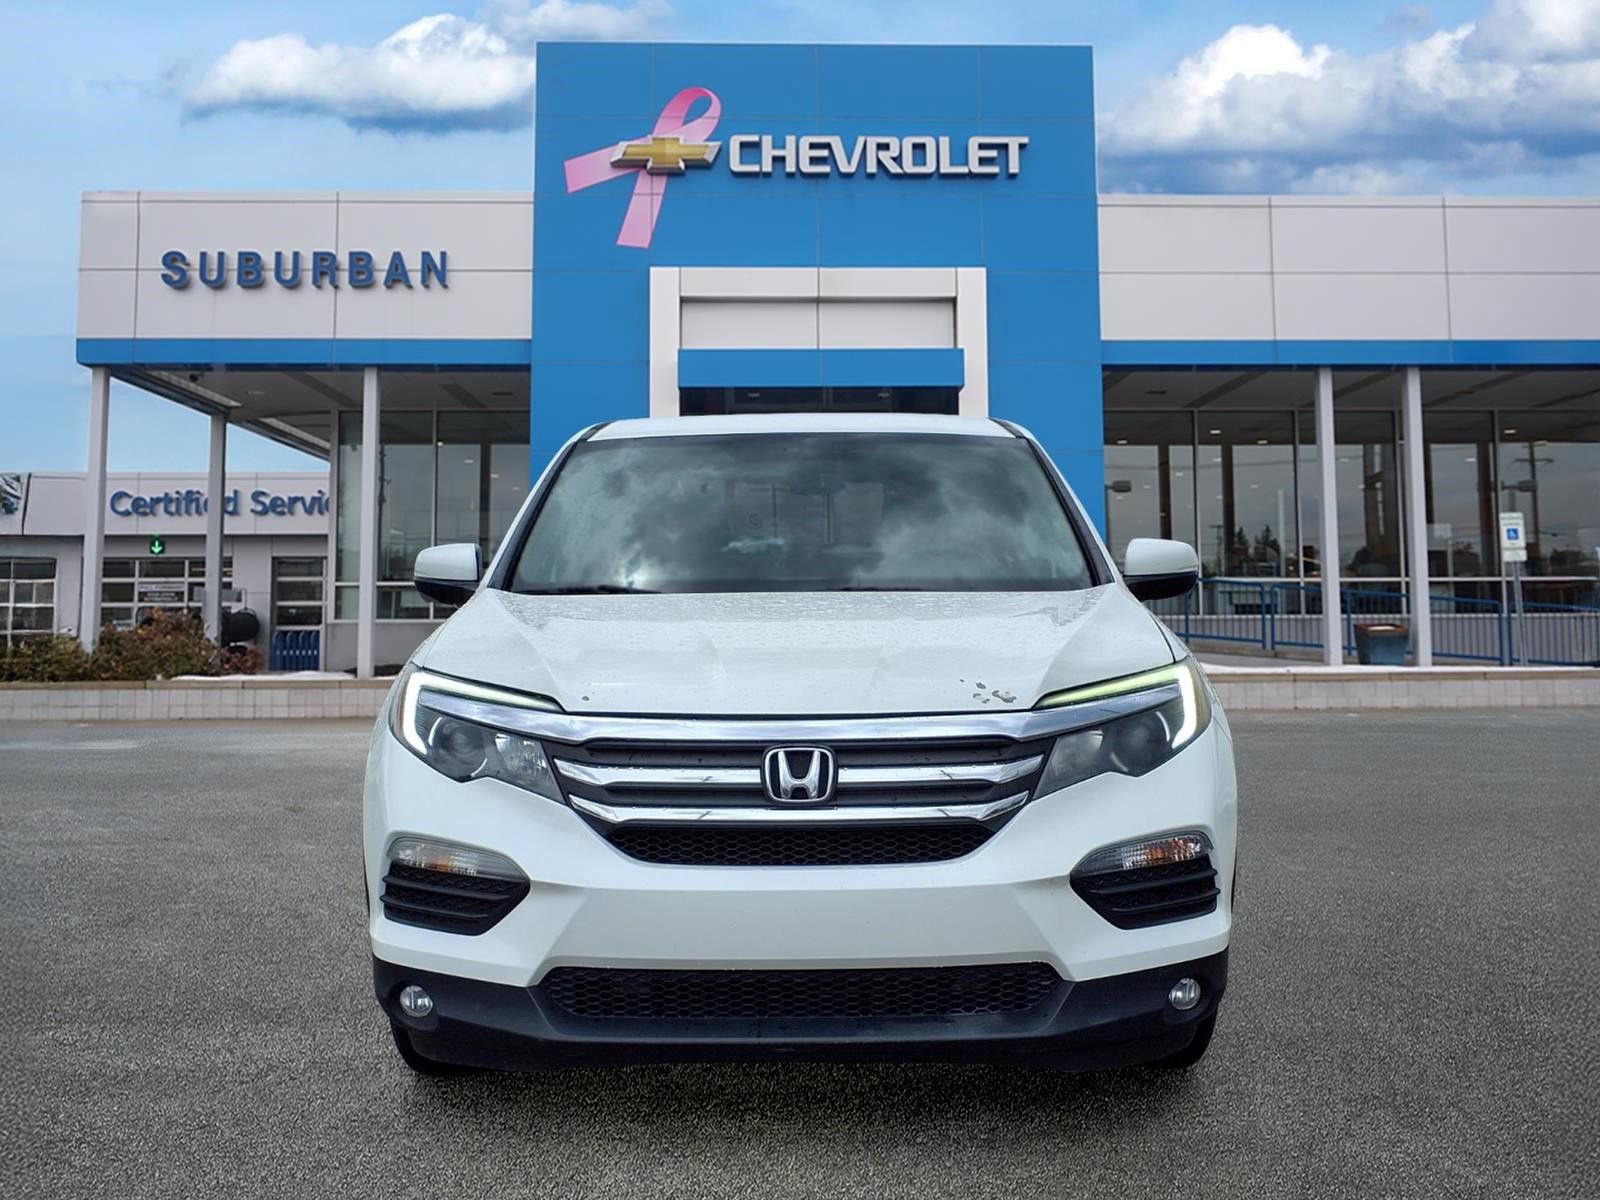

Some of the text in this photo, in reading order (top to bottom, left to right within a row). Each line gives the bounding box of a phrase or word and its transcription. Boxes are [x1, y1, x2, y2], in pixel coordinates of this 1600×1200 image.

[728, 134, 1029, 176] CHEVROLET
[160, 250, 449, 289] SUBURBAN
[109, 489, 329, 517] Certifid Servi
